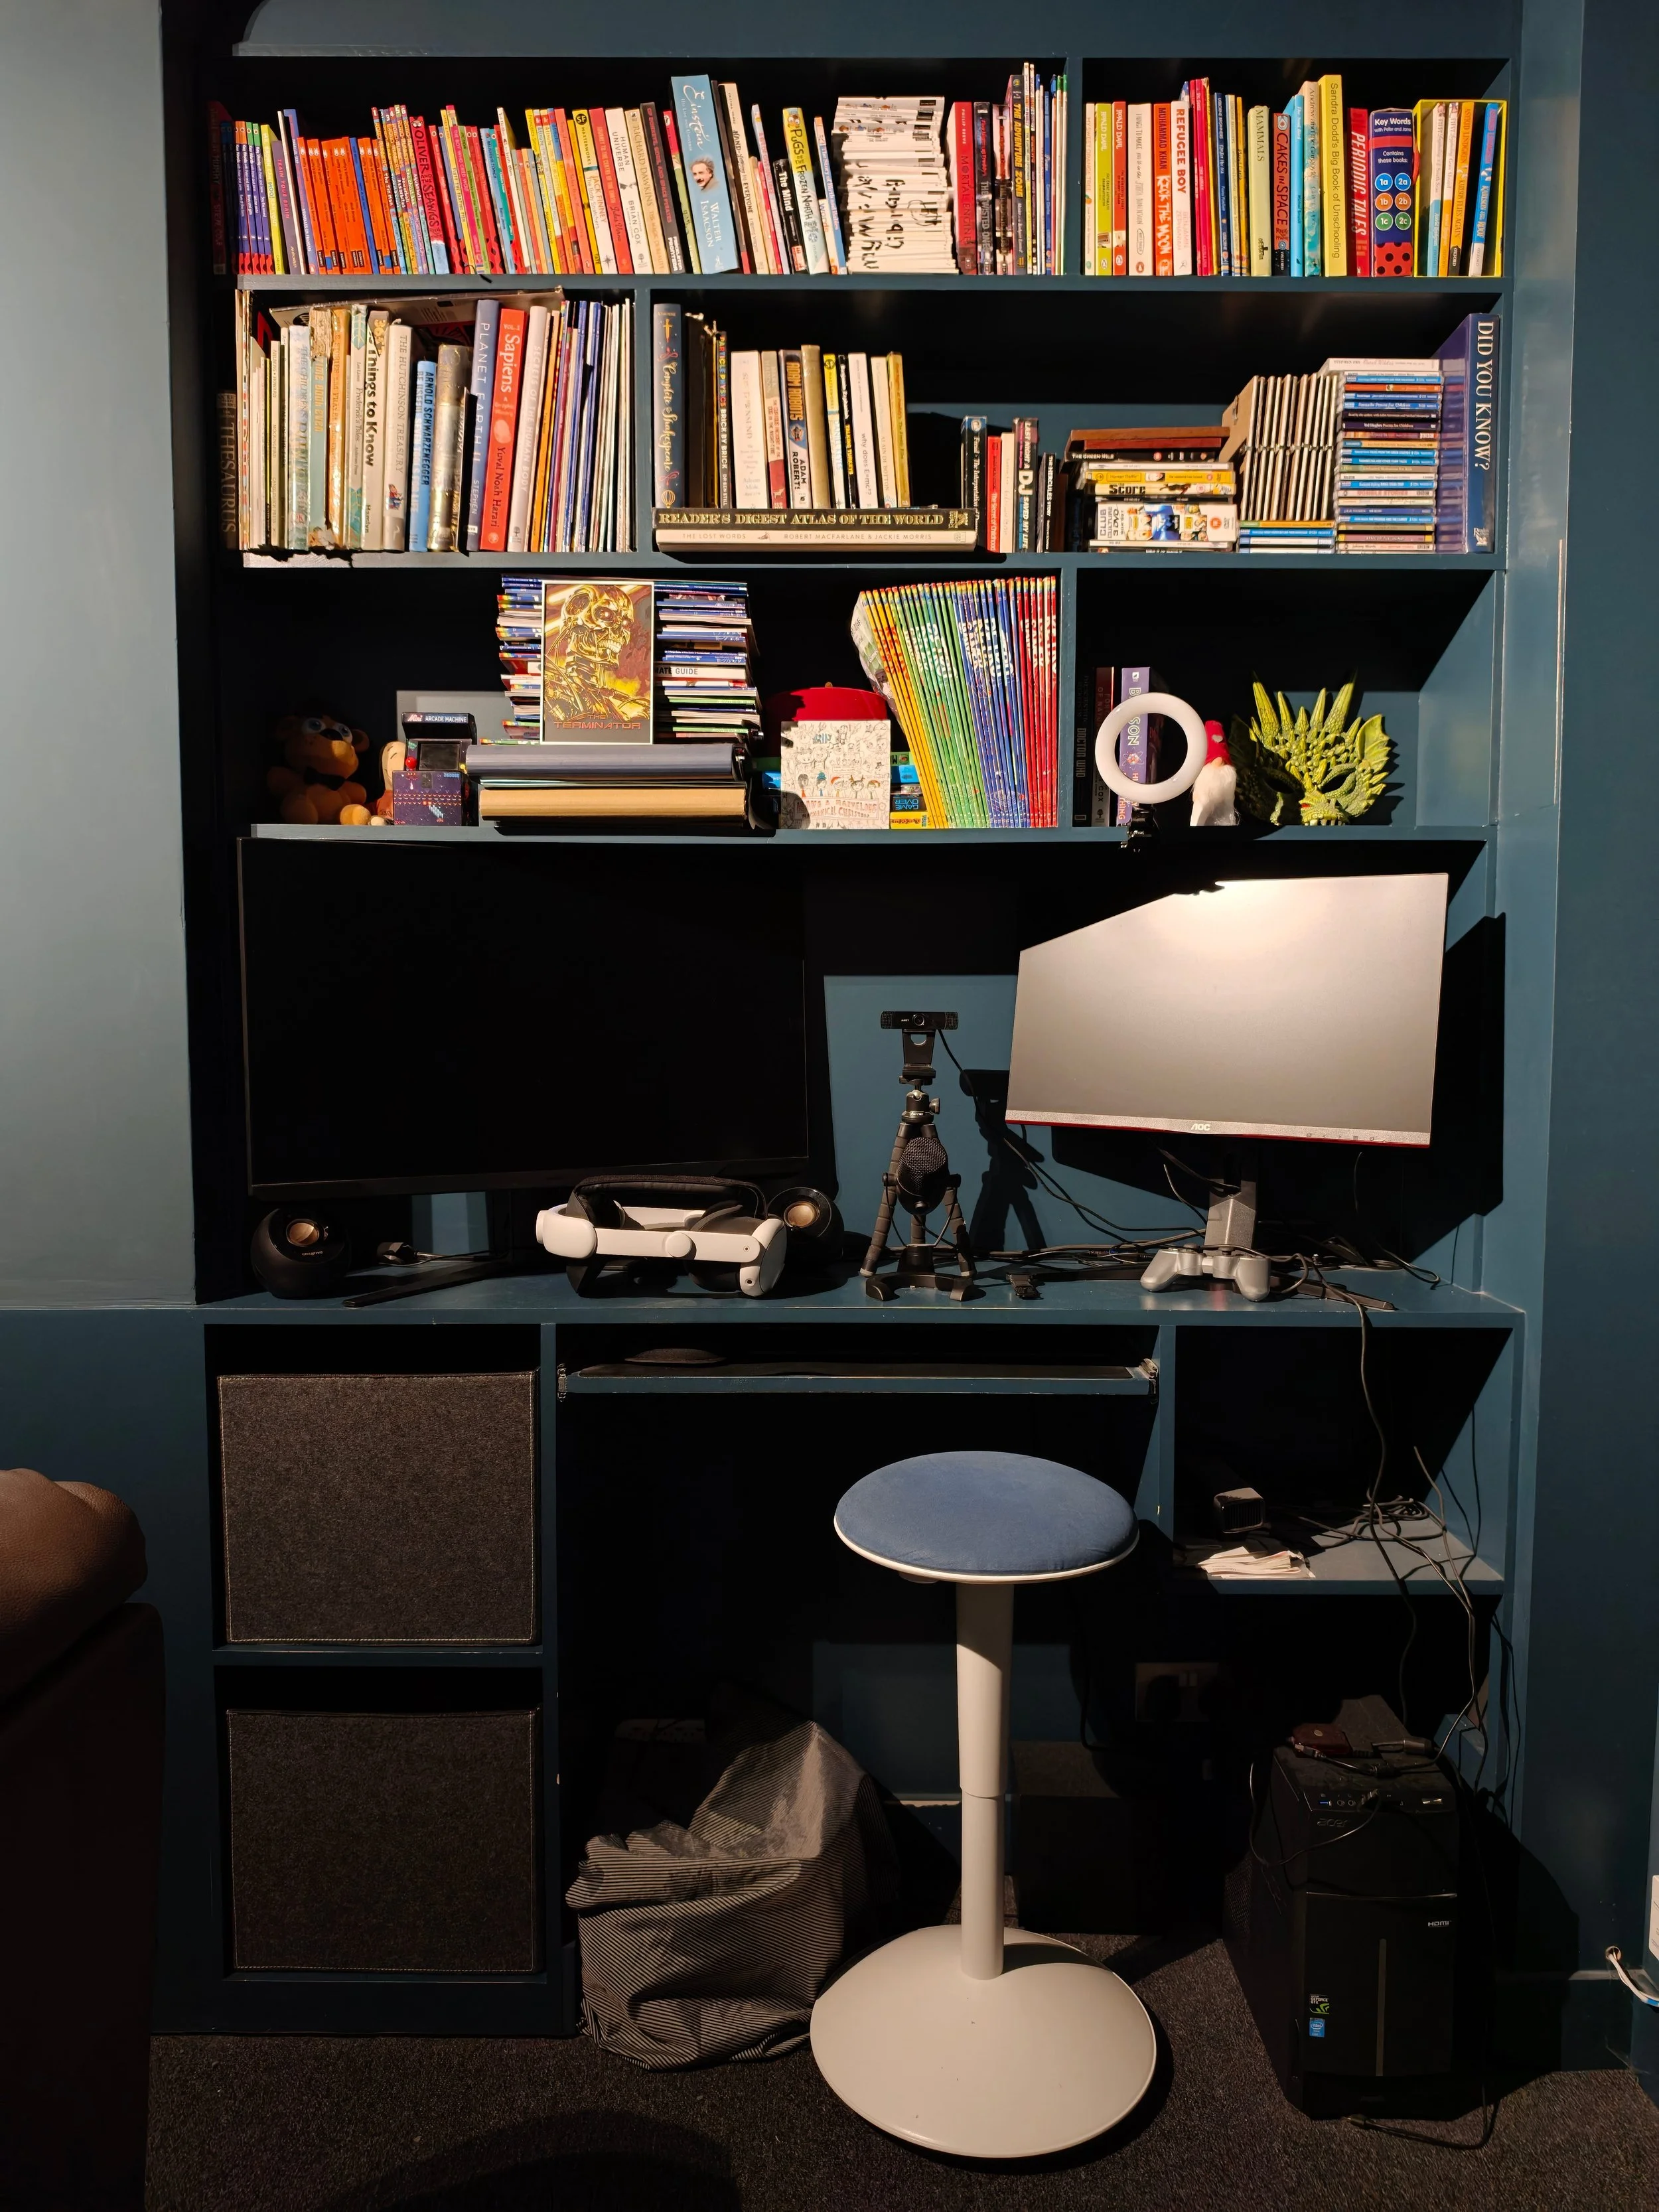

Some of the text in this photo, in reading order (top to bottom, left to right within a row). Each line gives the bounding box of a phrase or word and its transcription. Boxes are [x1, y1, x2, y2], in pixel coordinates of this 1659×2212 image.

[682, 85, 711, 151] Einstein
[1330, 82, 1339, 115] Sandra
[790, 129, 805, 155] PUGS
[1158, 107, 1168, 170] MUHAMMAD KHAN
[1256, 109, 1265, 162] MAMMALS
[1331, 117, 1340, 149] Dodd's
[1374, 118, 1388, 127] Key
[414, 129, 429, 174] OLIVER
[581, 127, 592, 166] MASTERWORKS
[612, 131, 624, 173] UNIVERSE
[620, 135, 631, 166] HUMAN
[633, 125, 654, 206] RICHARD DAWKINS
[1013, 103, 1023, 198] THE ADVENTURE ZONE
[1176, 108, 1187, 194] REFUGEE BOY
[1330, 151, 1340, 166] Big
[413, 173, 422, 201] Aquanauts
[743, 182, 754, 214] EVERYONE
[778, 171, 794, 212] The Mind
[794, 165, 814, 220] FROZEN NORTH
[960, 155, 972, 198] MORTAL
[1276, 132, 1289, 226] CAKES IN SPACE
[1332, 192, 1340, 202] of
[1350, 131, 1366, 235] PERIODIC TALES
[422, 184, 440, 228] SEAWIGS
[591, 175, 607, 224] JACK FINNEY
[1156, 175, 1171, 255] KICK THE MOON
[1380, 197, 1388, 206] 1b
[628, 200, 642, 245] BRIAN COX
[700, 200, 714, 248] ISAACSON
[709, 202, 723, 242] WALTER
[1331, 204, 1341, 258] Unschooling
[476, 322, 490, 384] PLANET
[499, 333, 521, 394] Sapiens
[354, 387, 364, 425] Frederick's
[364, 349, 378, 467] Things to Know
[396, 334, 407, 473] THE HUTCHINSON TREASURY
[658, 361, 679, 473] Complete Shakespeare
[1473, 321, 1494, 471] DID YOU KNOW?
[421, 371, 435, 486] ARNOLD SCHWARZENEGGER
[520, 345, 542, 492] SECRETS OF THE HUMAN BODY
[721, 434, 727, 445] BY
[220, 421, 237, 533] THESAURUS
[490, 447, 506, 528] Yuval Noah Harari
[792, 451, 801, 490] ROBERTS
[1018, 469, 1034, 496] DJ
[1109, 485, 1146, 495] Score
[470, 479, 480, 514] STEPHEN
[658, 513, 944, 526] READER'S DIGEST ATLAS OF THE WORLD
[1023, 521, 1029, 534] MY
[553, 721, 642, 730] TERMINATOR
[1076, 727, 1087, 778] DOCTOR WHO
[1317, 1818, 1349, 1828] acer
